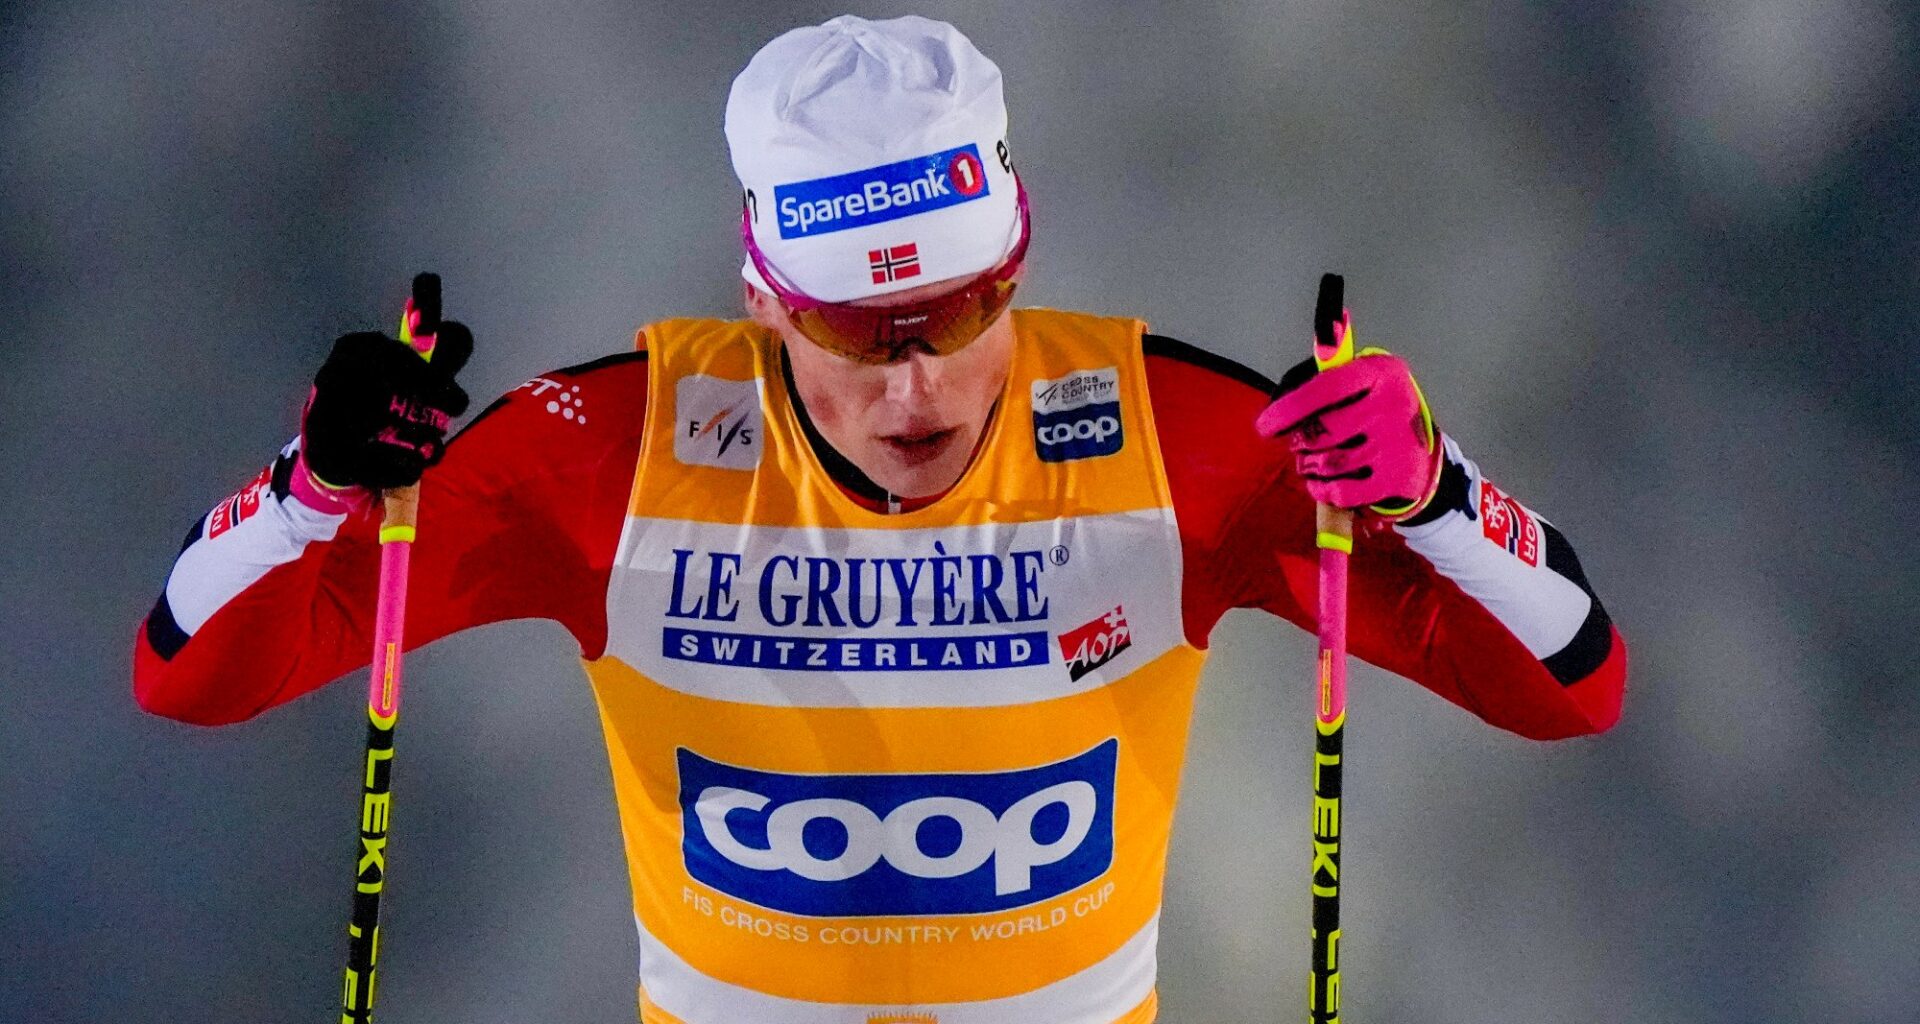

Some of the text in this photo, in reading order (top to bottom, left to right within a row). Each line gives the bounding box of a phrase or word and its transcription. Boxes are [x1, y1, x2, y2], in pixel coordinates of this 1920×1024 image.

[780, 158, 972, 233] SpareBank 1
[1062, 381, 1114, 399] COUNTRY
[1037, 416, 1119, 446] coop
[665, 548, 741, 622] LE
[679, 633, 1032, 668] SWITZERLAND
[1065, 622, 1131, 676] AOP
[357, 748, 394, 894] LEKI
[695, 780, 1097, 896] coop
[1312, 753, 1340, 897] LEKI
[683, 882, 1118, 945] FIS CROSS COUNTRY WORLD CUP
